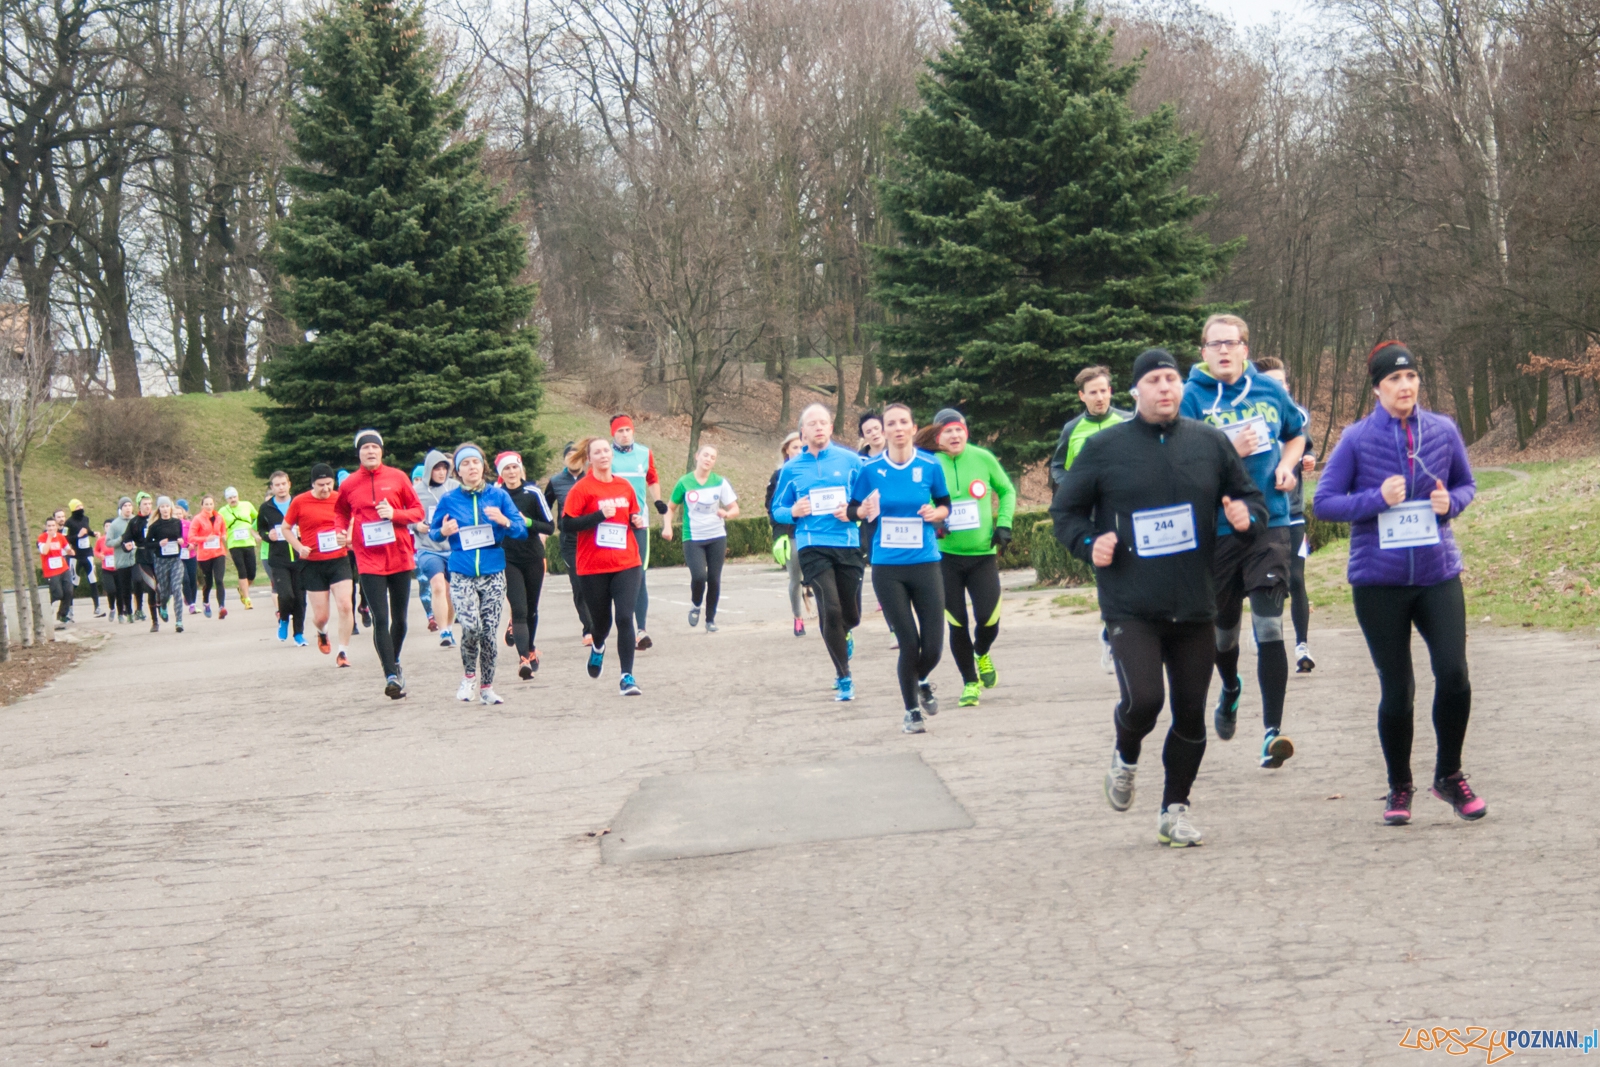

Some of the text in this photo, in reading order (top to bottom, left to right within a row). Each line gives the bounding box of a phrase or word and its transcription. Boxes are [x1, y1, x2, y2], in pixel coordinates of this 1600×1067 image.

[822, 493, 835, 501] 880
[953, 508, 966, 516] 110
[1399, 513, 1419, 525] 243
[1154, 519, 1175, 532] 244
[894, 526, 909, 534] 813
